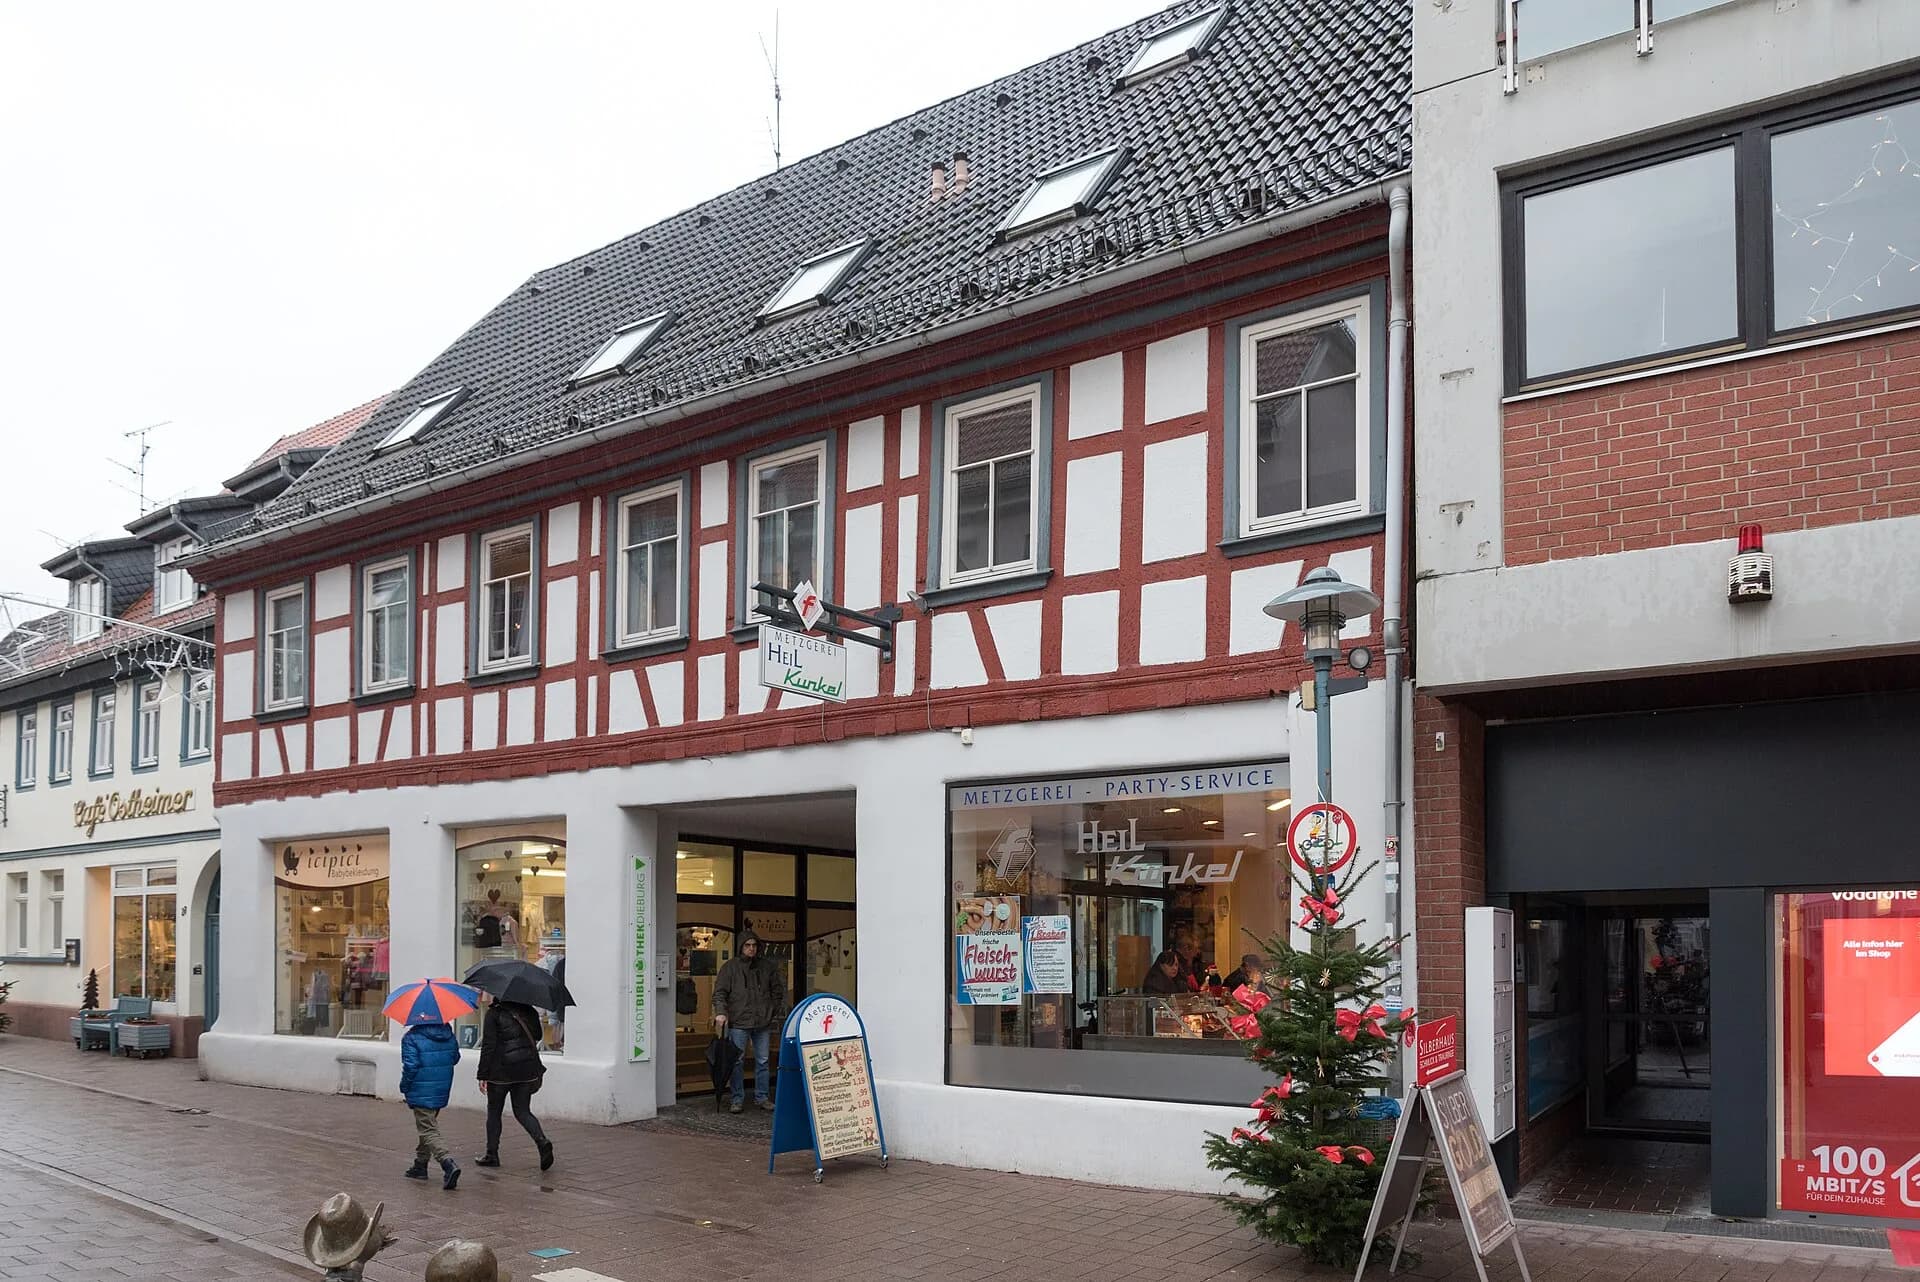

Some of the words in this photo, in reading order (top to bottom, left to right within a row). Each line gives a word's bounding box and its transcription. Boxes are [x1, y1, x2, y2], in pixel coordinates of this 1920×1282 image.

[768, 642, 802, 669] HEIL
[774, 631, 837, 657] METZGEREI
[784, 668, 843, 697] Kunkel
[964, 785, 1072, 806] METZGEREI
[1105, 769, 1275, 797] PARTY-SERVICE
[108, 786, 193, 821] Ostheimer
[1076, 818, 1146, 854] HEIL
[1105, 850, 1244, 887] Kunkel
[964, 943, 1018, 965] Fleisch-
[1843, 940, 1861, 948] Alle
[1862, 940, 1885, 948] Infos
[1885, 940, 1905, 948] hier
[1869, 949, 1891, 959] Shop
[974, 963, 1018, 982] wurst
[804, 1004, 851, 1024] Metzgerei
[1419, 1032, 1455, 1056] SILBERHAUS
[1437, 1090, 1471, 1130] SILBER
[1811, 1144, 1886, 1177] 100
[1806, 1176, 1886, 1195] MBIT/S
[1806, 1191, 1823, 1201] FÜR
[1824, 1194, 1844, 1203] DEIN
[1845, 1195, 1886, 1206] ZUHAUSE
